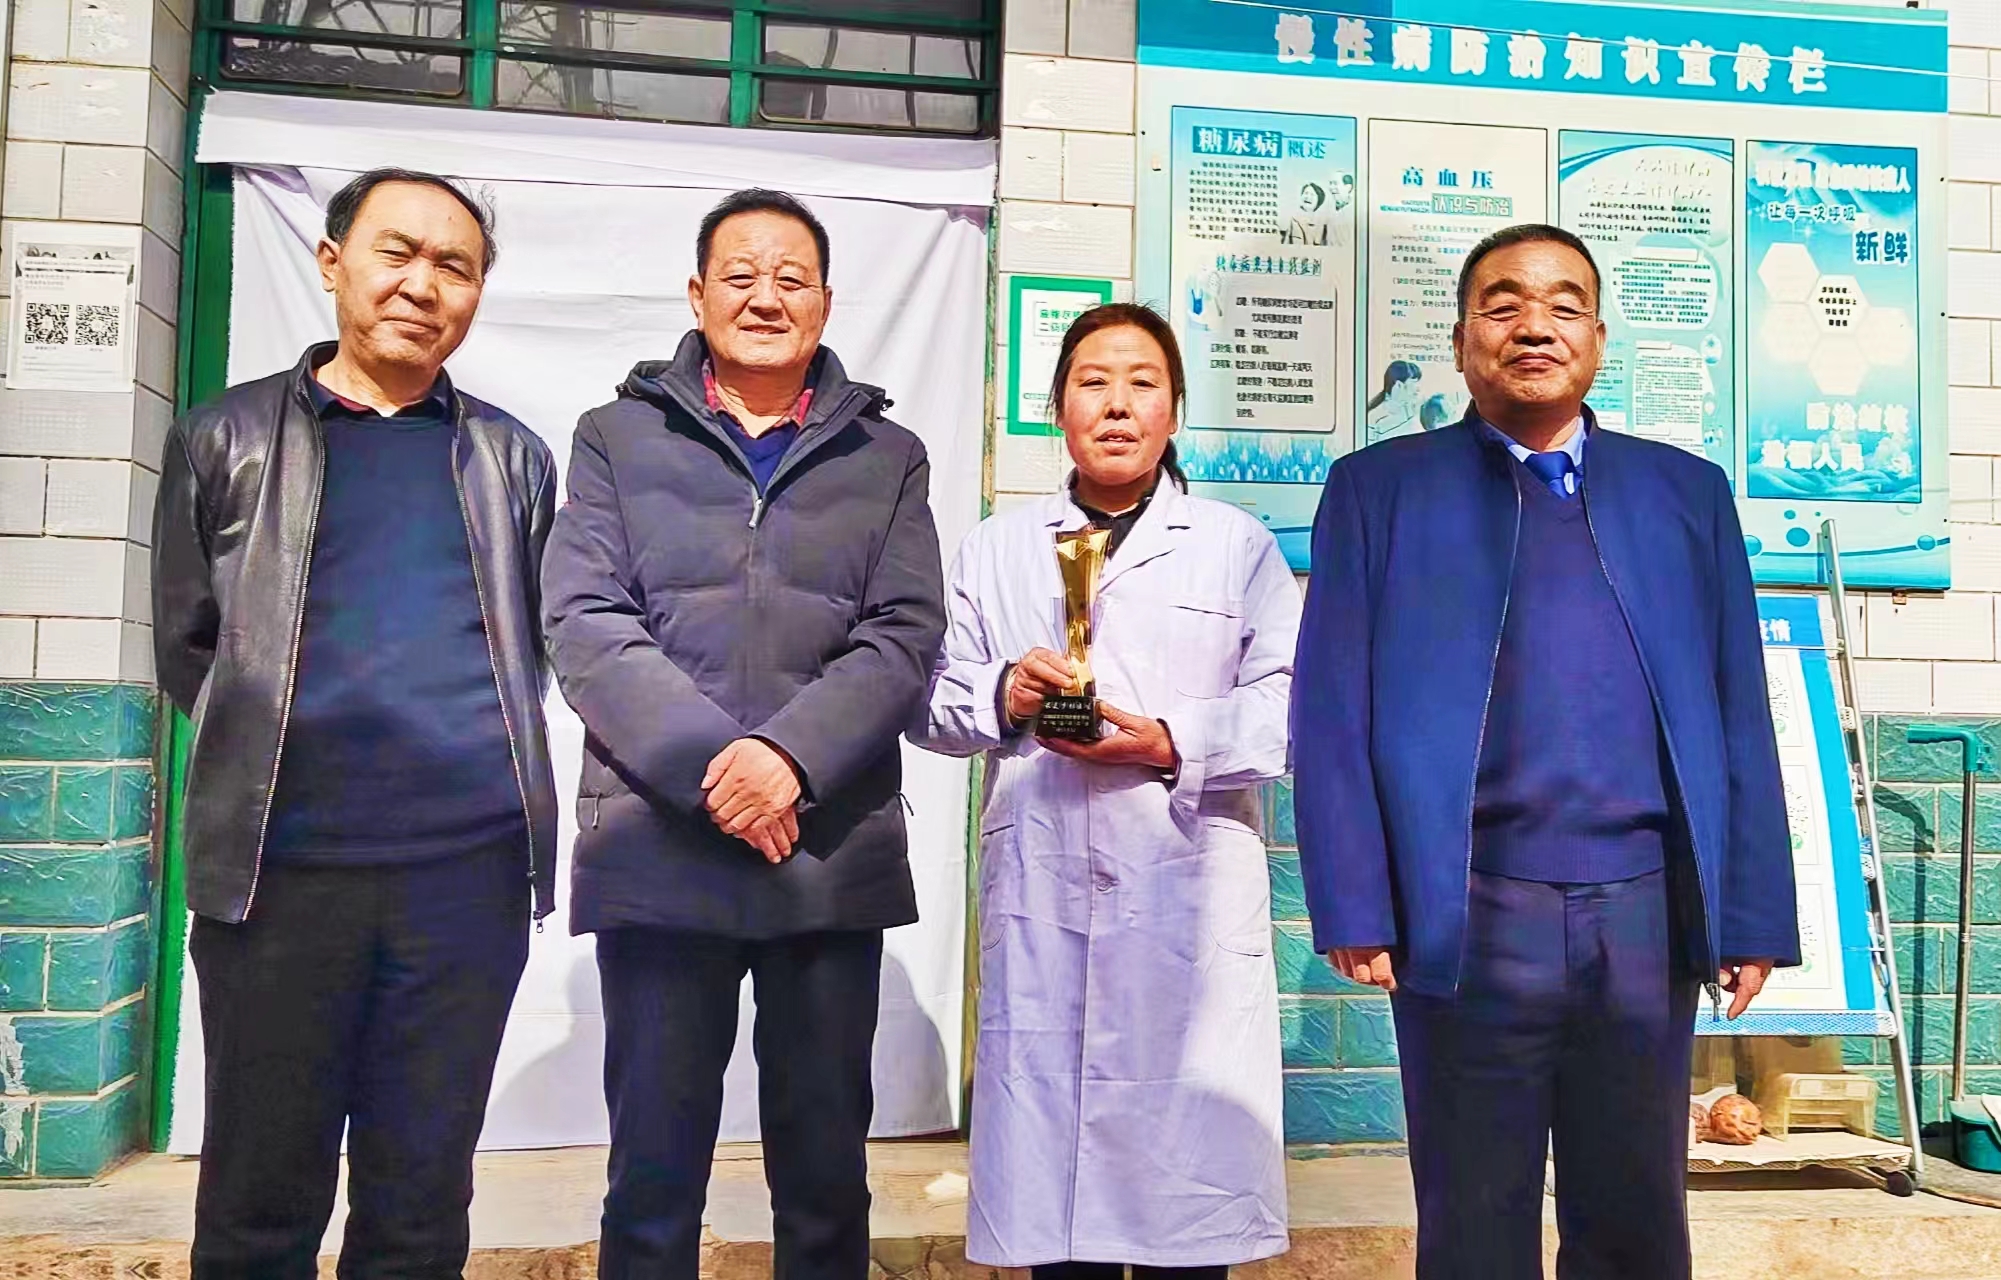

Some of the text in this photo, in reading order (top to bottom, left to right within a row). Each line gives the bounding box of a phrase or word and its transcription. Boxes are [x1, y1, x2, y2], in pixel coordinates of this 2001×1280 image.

[1275, 13, 1827, 94] 慢性病防治知识宣传栏
[1197, 127, 1326, 159] 糖尿病 概述
[1402, 166, 1494, 189] 高血压
[1434, 195, 1510, 216] 认识与防治
[1769, 203, 1857, 222] 让每一次呼吸
[1854, 230, 1908, 264] 新鲜
